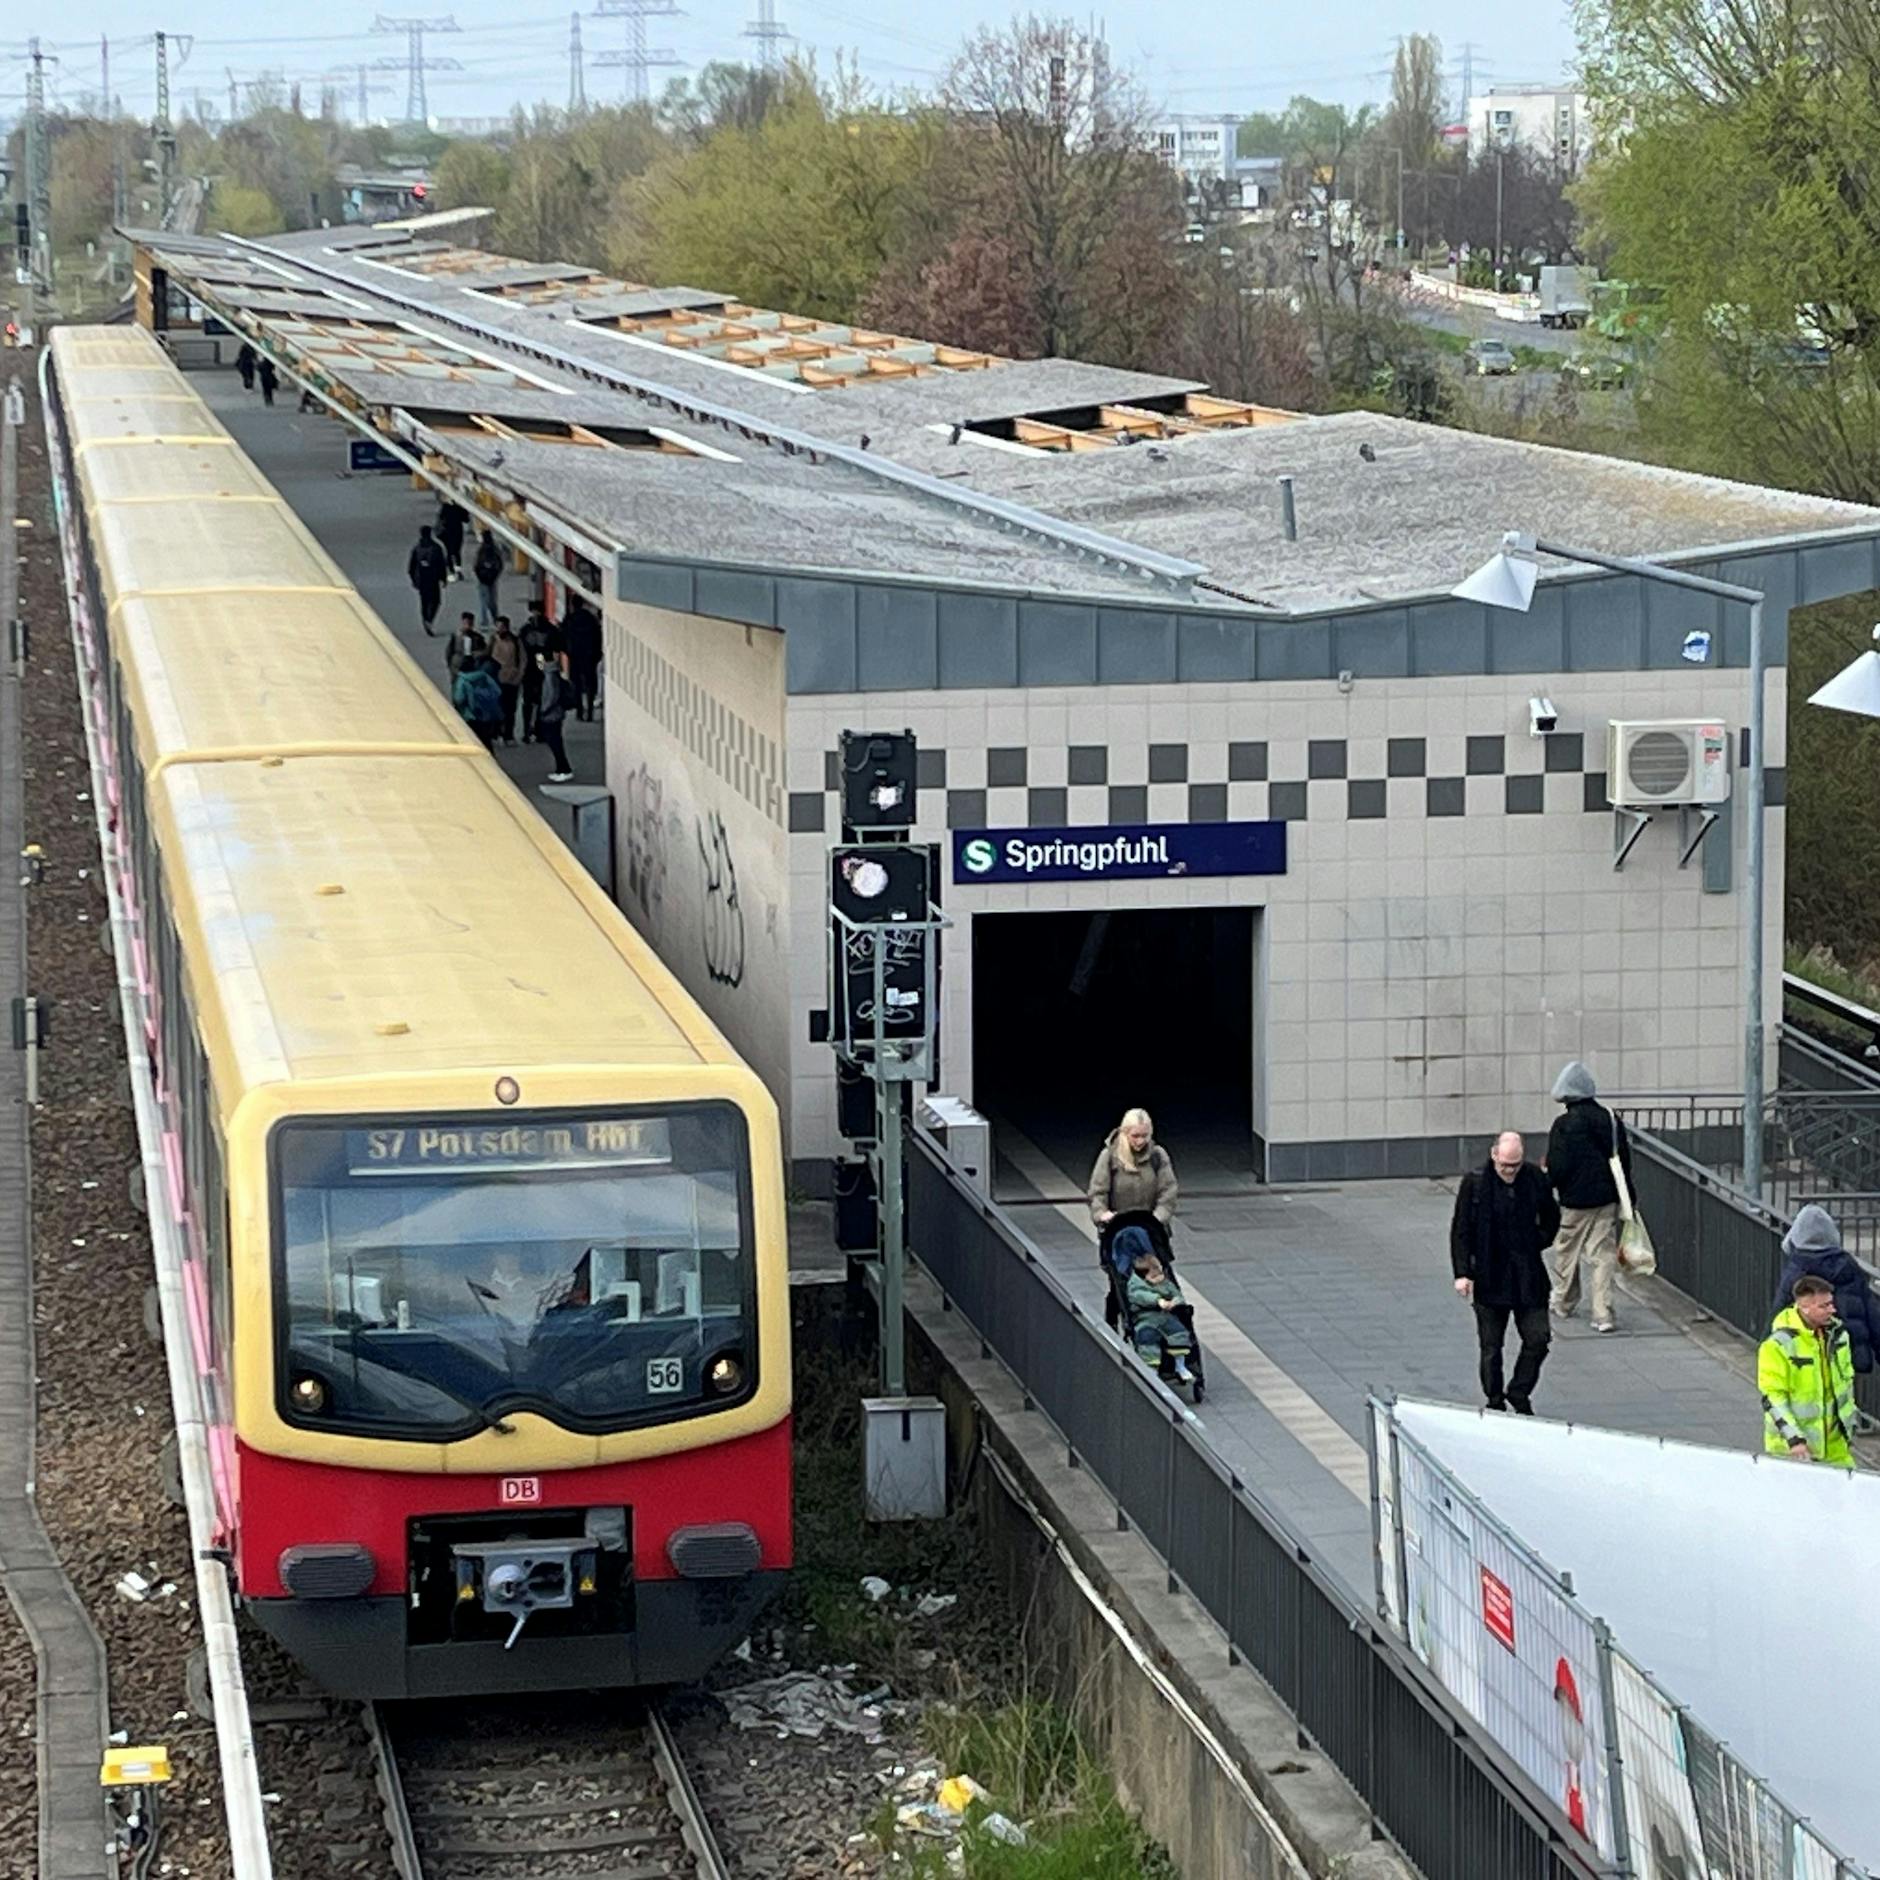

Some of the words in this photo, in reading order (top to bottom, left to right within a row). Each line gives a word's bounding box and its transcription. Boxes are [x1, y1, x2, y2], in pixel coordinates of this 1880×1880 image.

[965, 839, 995, 873] S
[1006, 836, 1169, 872] Springpfuhl
[367, 1128, 405, 1160] S7
[419, 1126, 574, 1158] Potsdam
[650, 1361, 680, 1388] 56
[506, 1480, 535, 1499] DB
